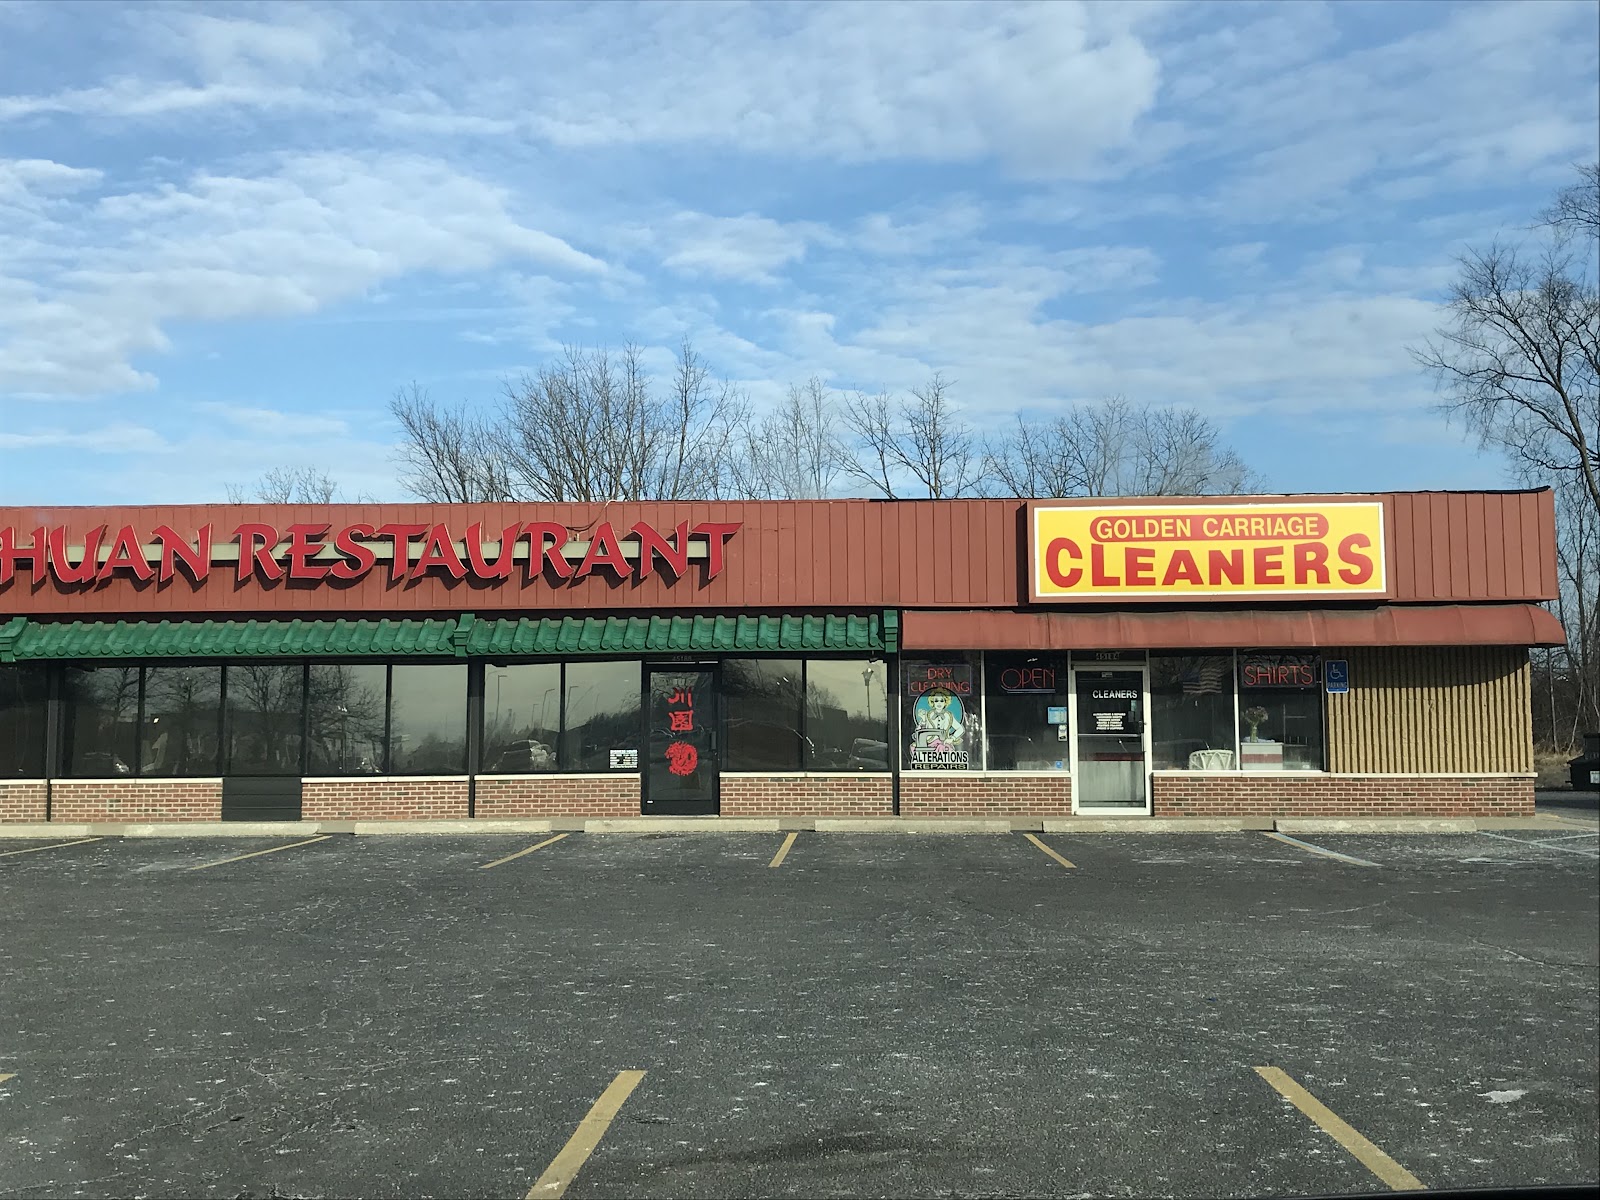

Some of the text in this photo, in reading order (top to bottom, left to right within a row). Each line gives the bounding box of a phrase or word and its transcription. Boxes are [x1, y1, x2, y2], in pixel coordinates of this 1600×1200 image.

[1096, 517, 1320, 539] GOLDEN CARRIAGE
[232, 520, 745, 580] RESTAURANT
[1045, 533, 1375, 588] CLEANERS
[927, 667, 952, 680] DRY
[1001, 668, 1055, 689] OPEN
[1244, 665, 1313, 685] SHIRTS
[1092, 690, 1138, 699] CLEANERS
[912, 751, 968, 763] ALTERATIONS
